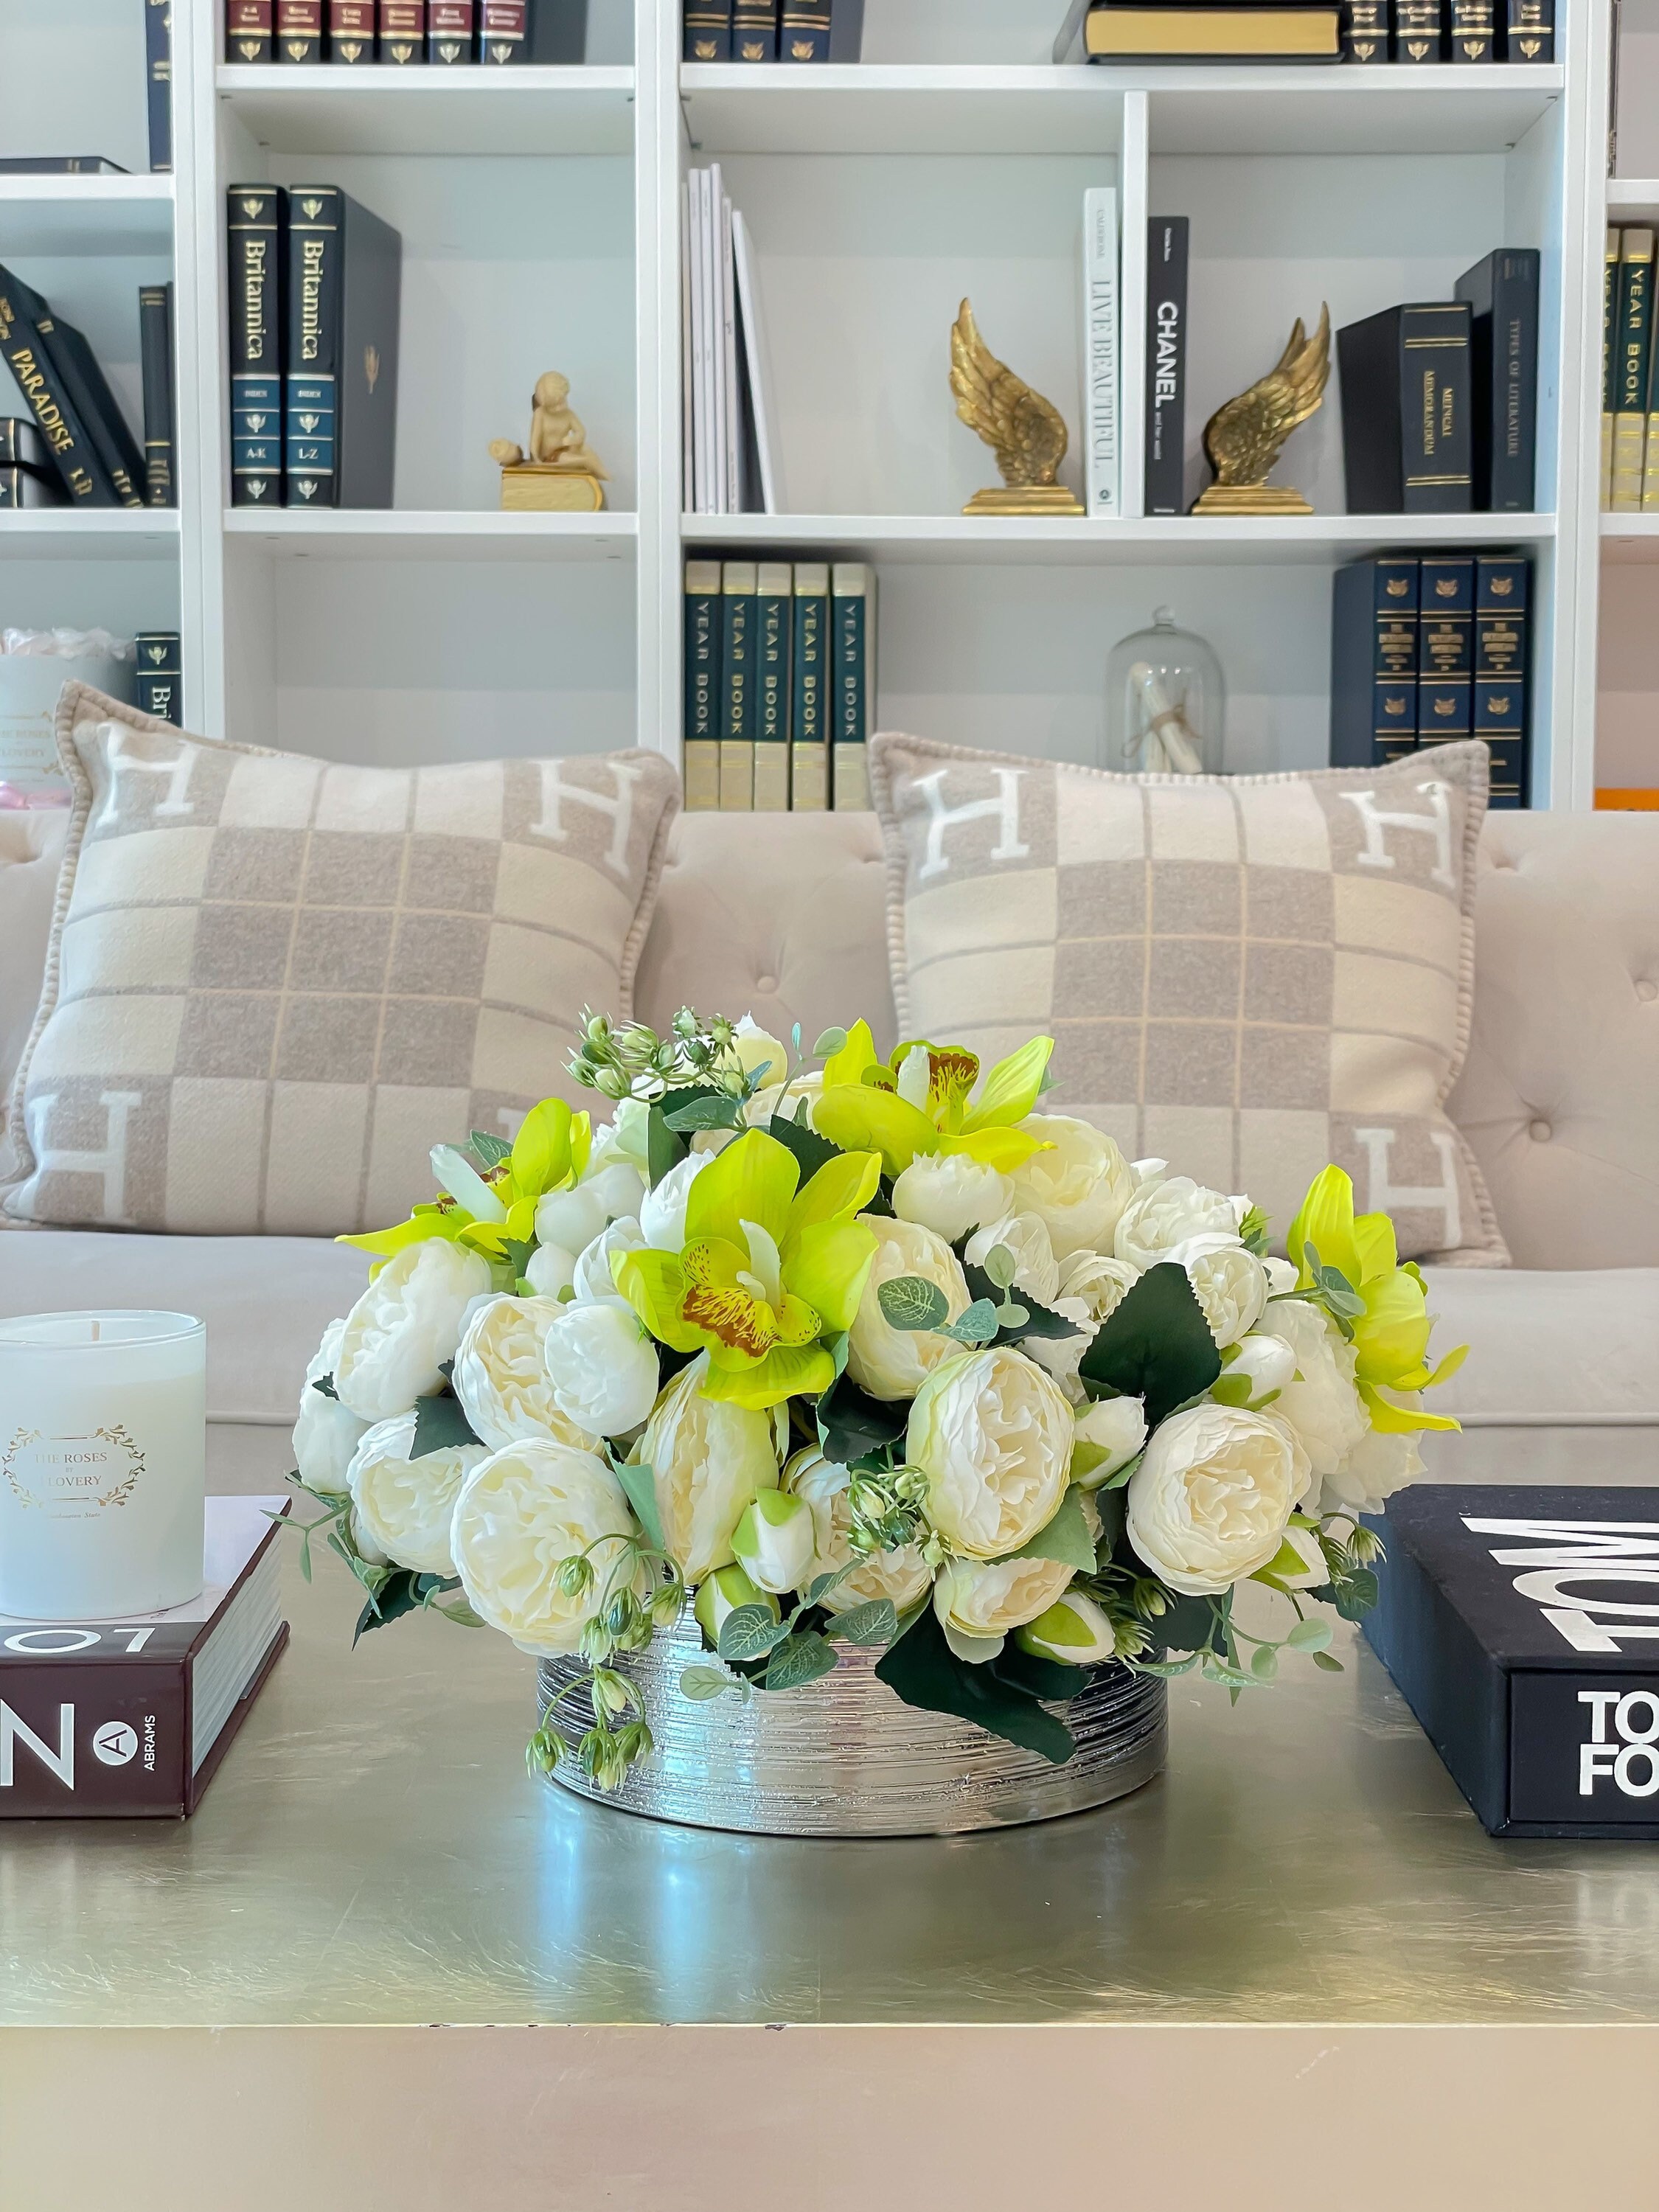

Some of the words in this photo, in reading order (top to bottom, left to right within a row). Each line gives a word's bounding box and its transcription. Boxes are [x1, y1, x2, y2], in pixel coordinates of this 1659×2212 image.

[245, 240, 266, 361] Britannica
[302, 240, 324, 361] Britannica
[1091, 280, 1113, 333] LIVE
[1629, 269, 1646, 329] YEAR
[1154, 301, 1178, 408] CHANEL
[1624, 343, 1641, 405] BOOK
[10, 348, 74, 455] PARADISE
[1093, 338, 1114, 470] BEAUTIFUL
[298, 448, 319, 460] L-Z
[697, 601, 709, 661] YEAR
[732, 601, 745, 661] YEAR
[766, 602, 779, 662] YEAR
[803, 602, 817, 662] YEAR
[845, 603, 857, 663] YEAR
[695, 672, 709, 734] BOOK
[731, 672, 744, 734] BOOK
[765, 675, 777, 736] BOOK
[803, 675, 816, 736] BOOK
[844, 676, 857, 737] BOOK
[64, 1452, 108, 1464] ROSES
[144, 1714, 156, 1772] ABRAMS
[1577, 1690, 1659, 1743] TO
[1579, 1743, 1659, 1798] FO
